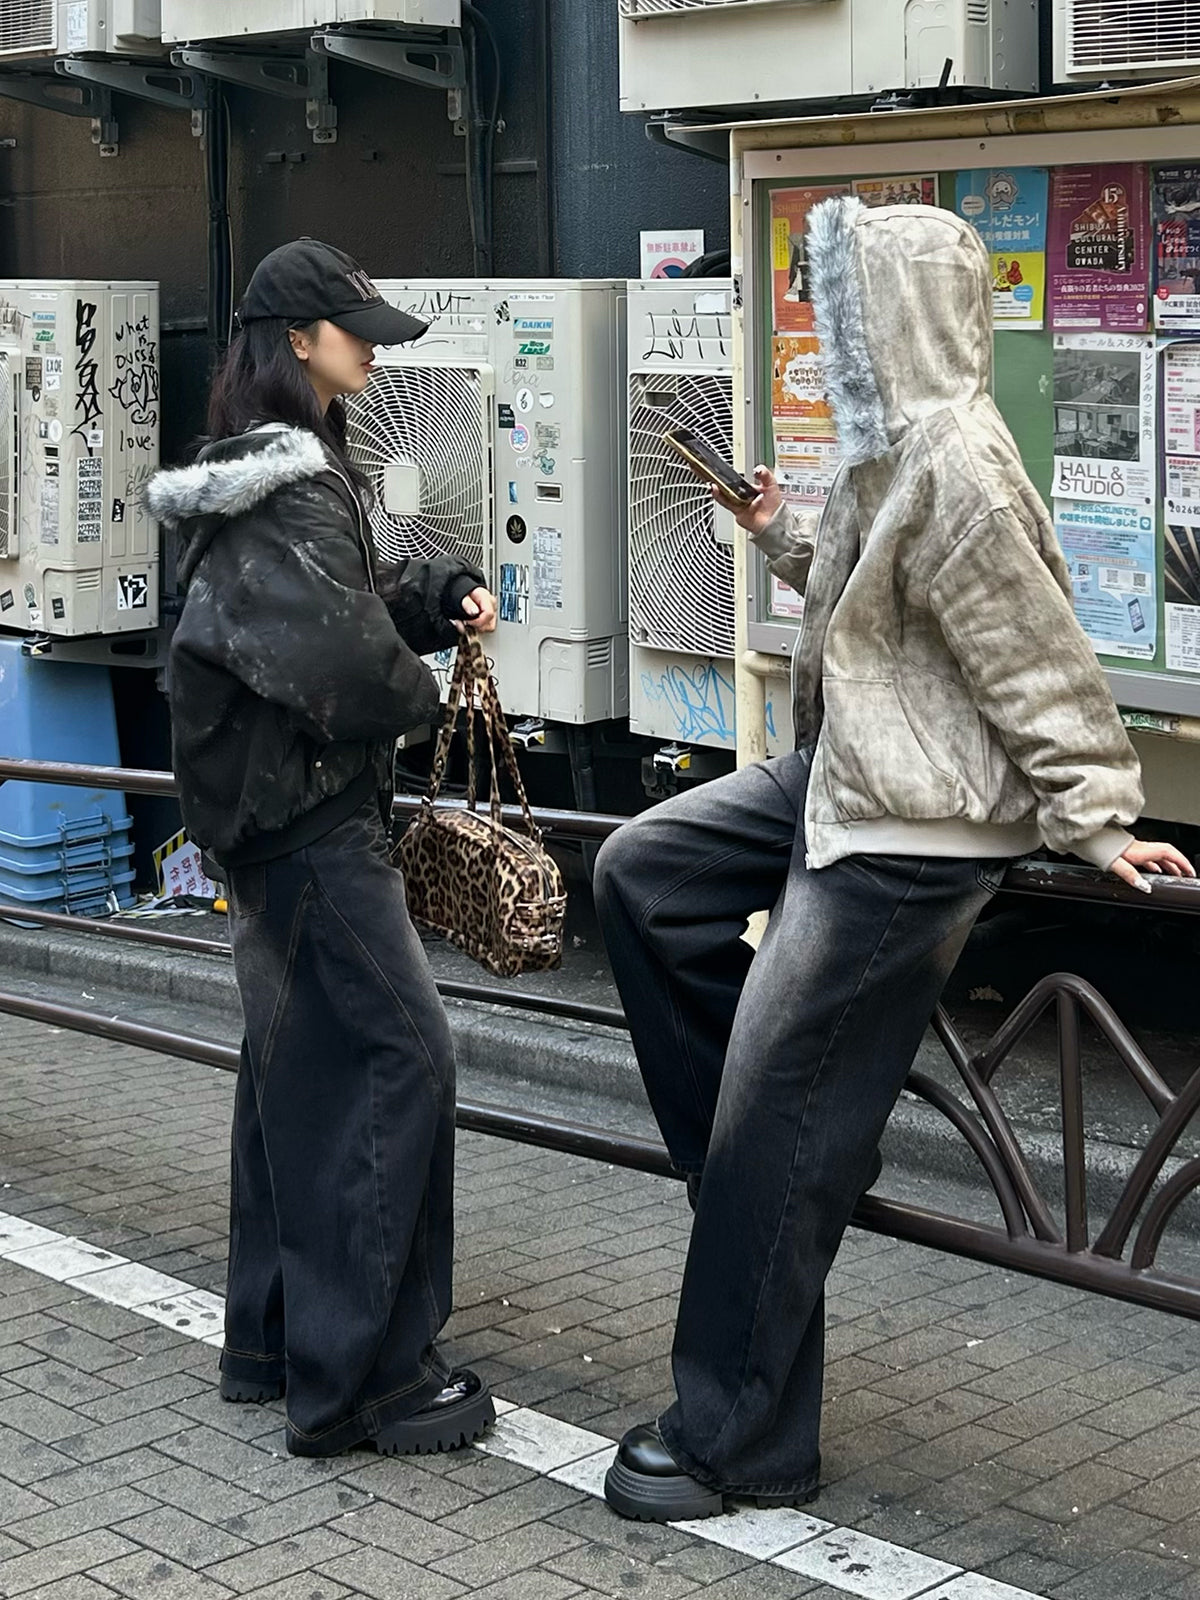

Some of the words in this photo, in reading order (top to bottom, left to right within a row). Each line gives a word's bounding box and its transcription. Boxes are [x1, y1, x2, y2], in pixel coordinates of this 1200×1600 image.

[1074, 223, 1111, 231] SHIBUYA
[647, 242, 697, 253] 無断駐車禁止
[1075, 245, 1109, 254] CENTER
[1075, 257, 1104, 266] OWADA
[522, 321, 552, 329] DAIKIN
[1060, 462, 1107, 479] HALL
[1111, 466, 1123, 480] &
[1059, 478, 1124, 497] STUDIO
